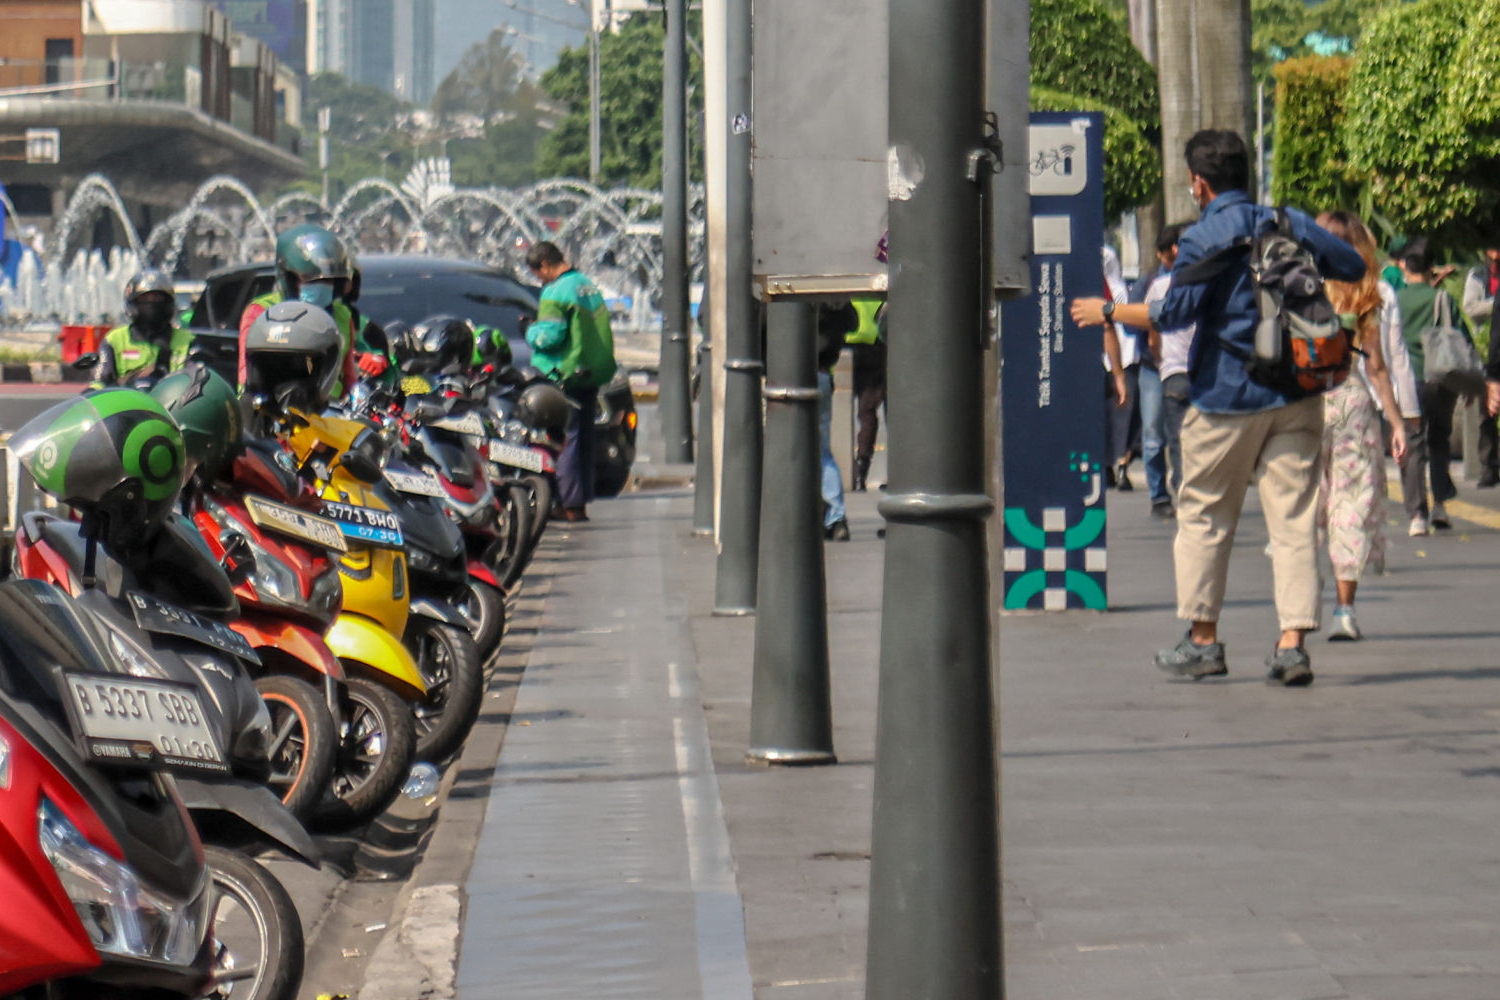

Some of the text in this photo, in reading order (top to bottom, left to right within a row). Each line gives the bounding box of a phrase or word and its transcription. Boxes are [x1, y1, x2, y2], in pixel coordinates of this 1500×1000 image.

[1053, 263, 1063, 295] Station
[1053, 297, 1065, 332] Sharing
[1038, 263, 1052, 408] Titik Tambat Sepeda Sewa
[326, 503, 362, 523] 5771
[75, 684, 199, 726] B 5337 SBB
[101, 744, 131, 758] YAMAHA
